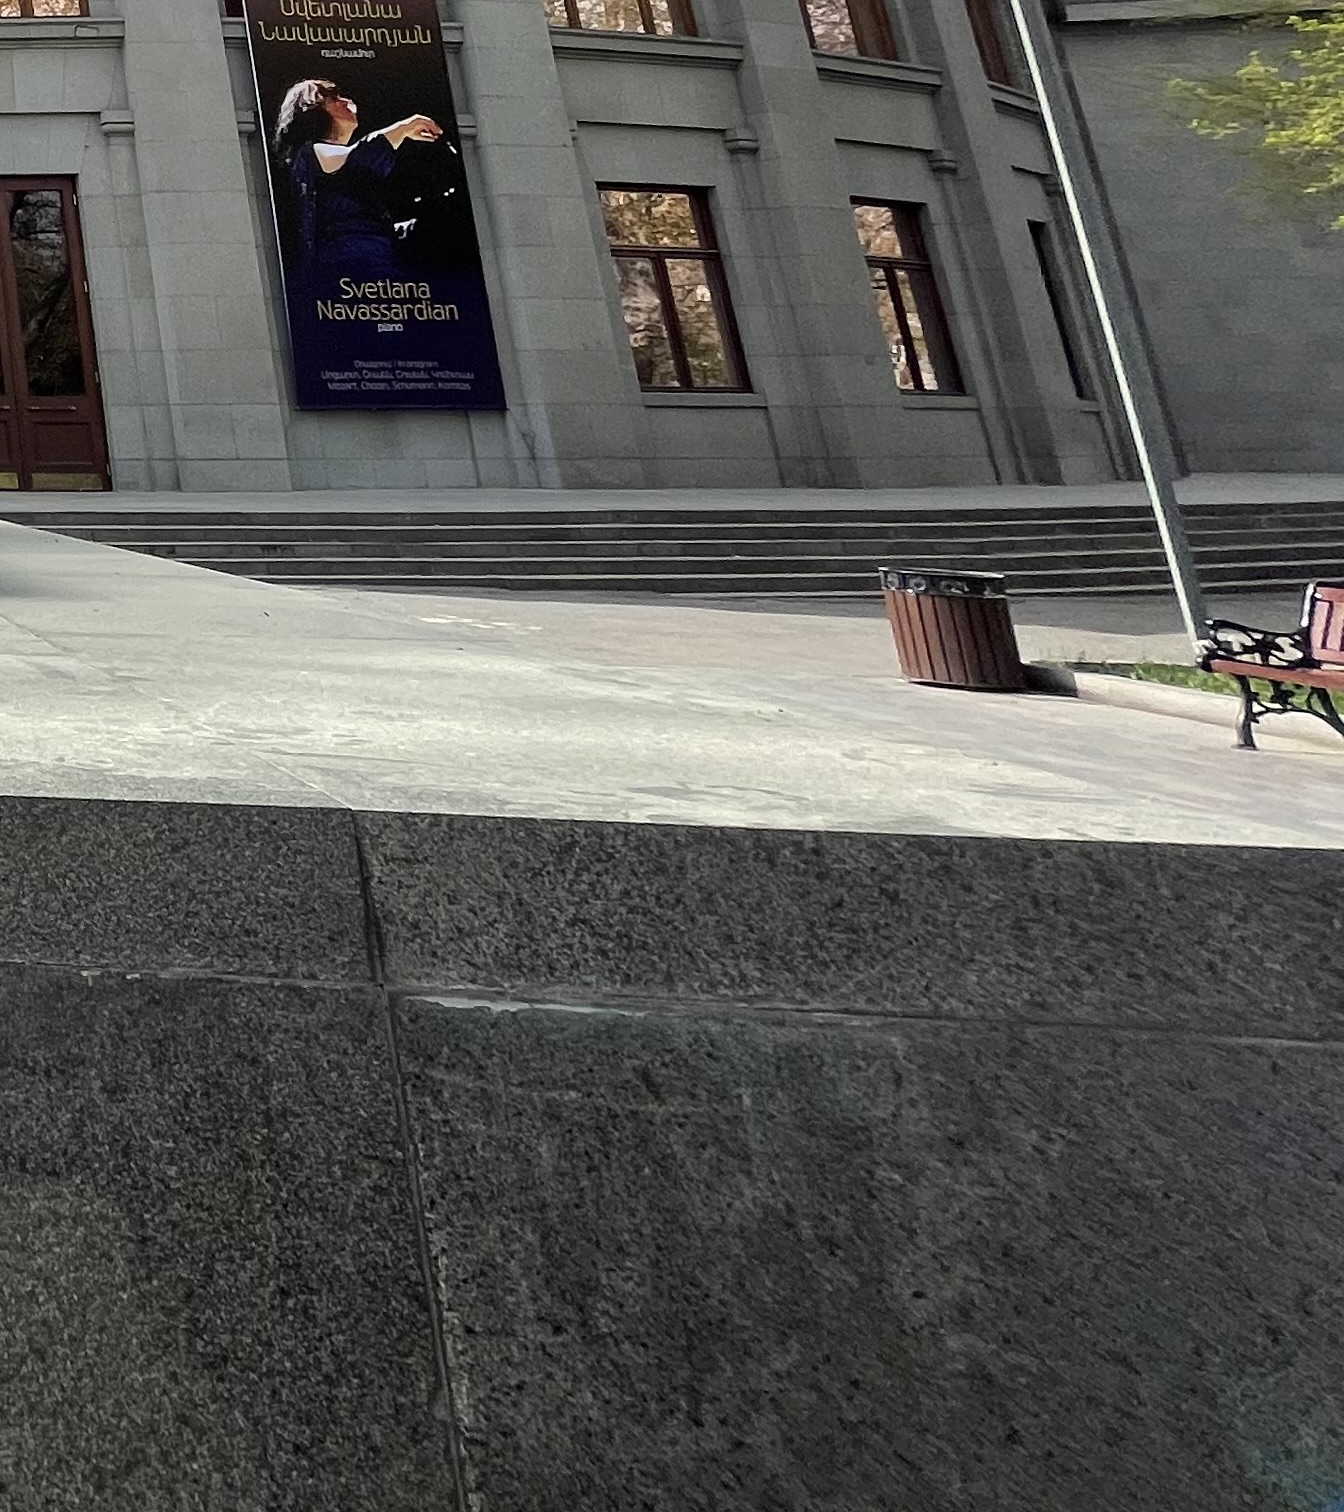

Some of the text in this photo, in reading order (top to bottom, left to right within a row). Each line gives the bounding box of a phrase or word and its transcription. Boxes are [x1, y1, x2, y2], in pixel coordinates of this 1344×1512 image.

[258, 21, 432, 48] Նավասարդյան
[339, 277, 431, 299] Svetlana
[316, 300, 459, 320] Navassardian
